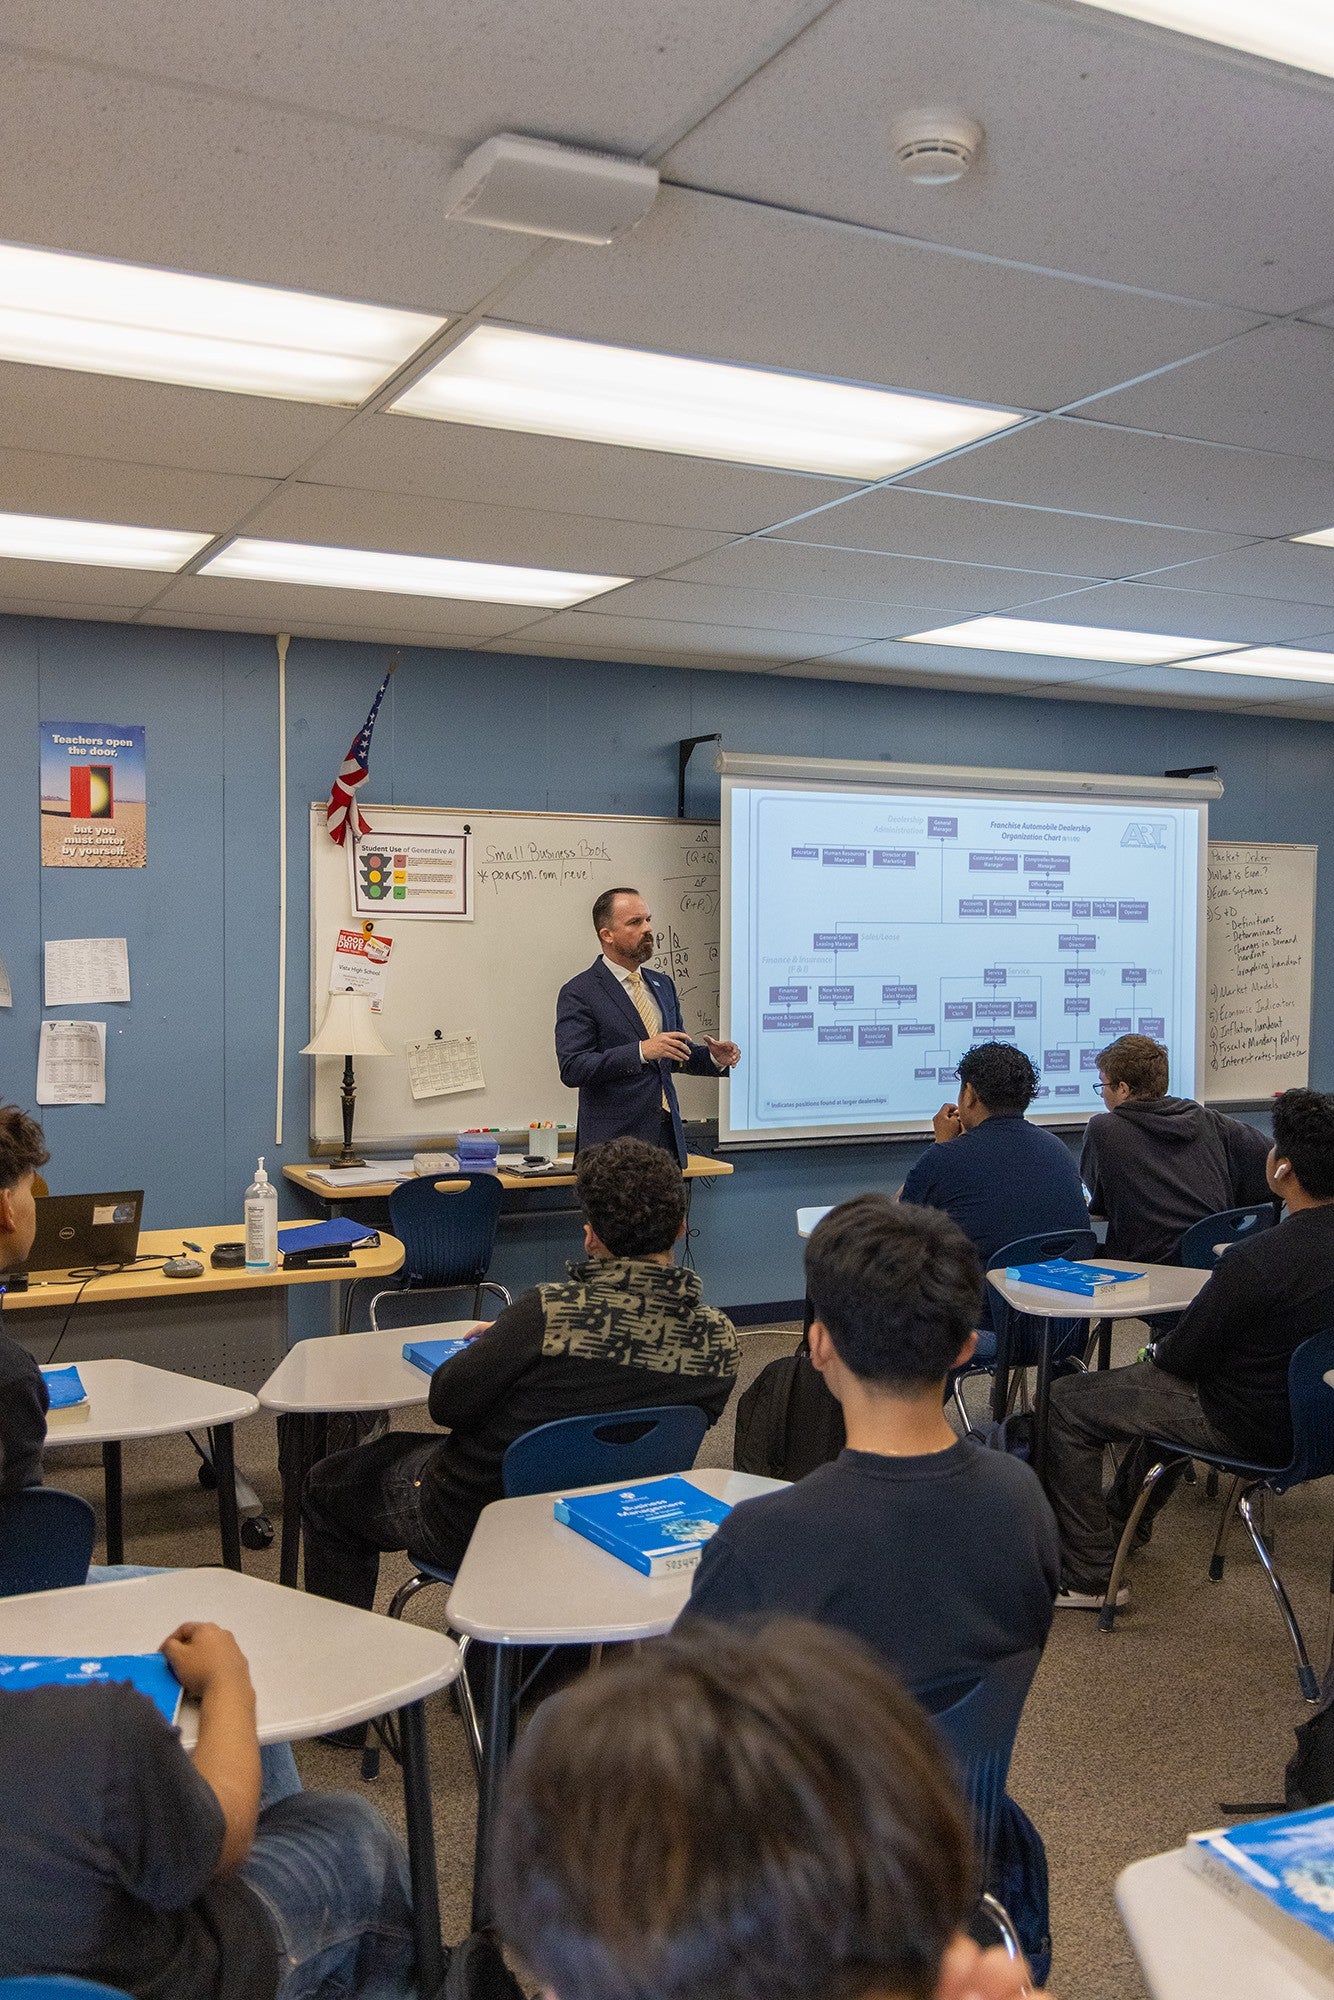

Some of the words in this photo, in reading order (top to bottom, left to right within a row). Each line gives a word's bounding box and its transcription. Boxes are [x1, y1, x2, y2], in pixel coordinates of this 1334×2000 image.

[52, 734, 103, 745] Teachers
[105, 739, 133, 748] open
[68, 746, 87, 755] the
[89, 747, 118, 757] door,
[73, 825, 93, 835] but
[95, 827, 116, 837] you
[990, 821, 1021, 830] Franchise
[1021, 822, 1057, 831] Automobile
[1058, 824, 1091, 833] Dealership
[1001, 832, 1043, 842] Organization
[1043, 833, 1062, 842] Chart
[1119, 822, 1167, 845] ART
[64, 837, 93, 845] must
[96, 837, 125, 845] enter
[62, 846, 77, 857] by
[80, 846, 128, 857] yourself.
[361, 845, 388, 853] Student
[485, 844, 524, 862] Small
[527, 842, 576, 861] Business
[577, 839, 611, 861] Book
[793, 849, 816, 857] Secretary
[339, 934, 364, 944] BLOOD
[338, 940, 364, 951] DRIVE
[674, 952, 689, 965] 20
[351, 966, 363, 974] High
[364, 968, 381, 976] School
[795, 1100, 820, 1109] positions
[820, 1099, 836, 1107] found
[616, 1501, 686, 1517] Management
[621, 1500, 668, 1511] Business
